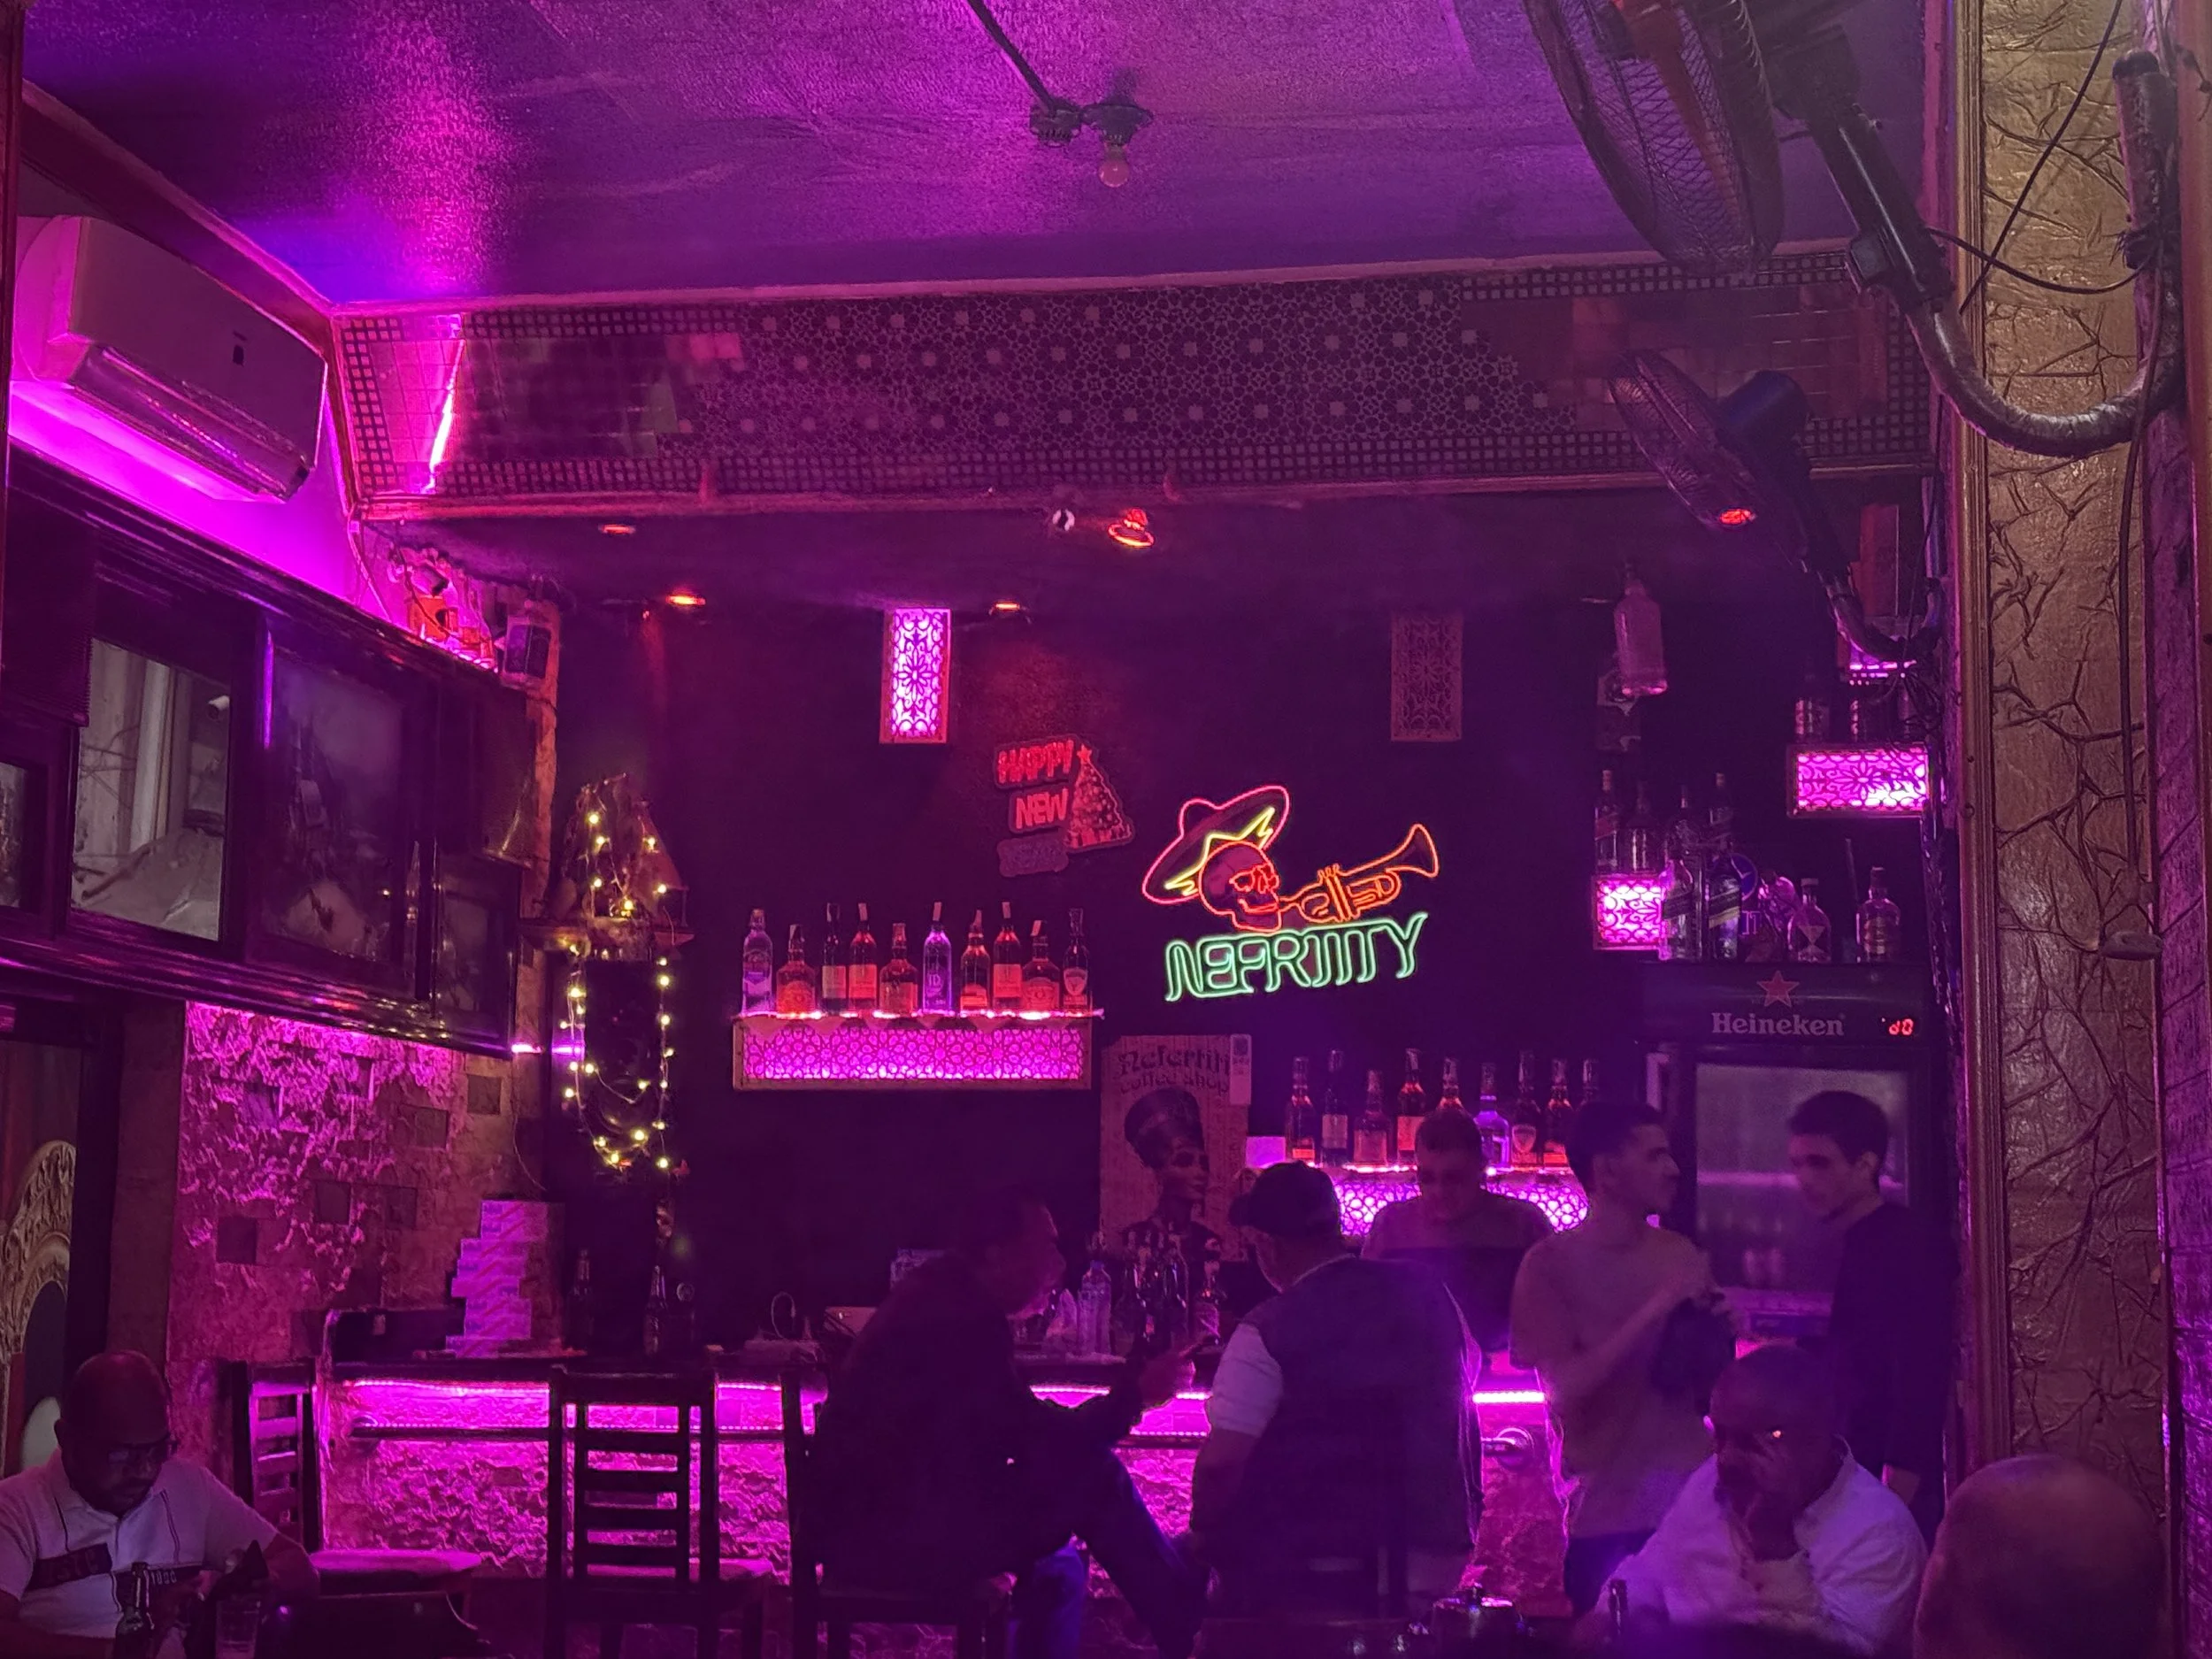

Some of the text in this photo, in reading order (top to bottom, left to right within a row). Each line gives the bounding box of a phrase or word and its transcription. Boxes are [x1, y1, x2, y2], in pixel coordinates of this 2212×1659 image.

[998, 741, 1074, 784] HAPPY
[1016, 787, 1069, 829] NEW
[1712, 1012, 1844, 1036] Heineken
